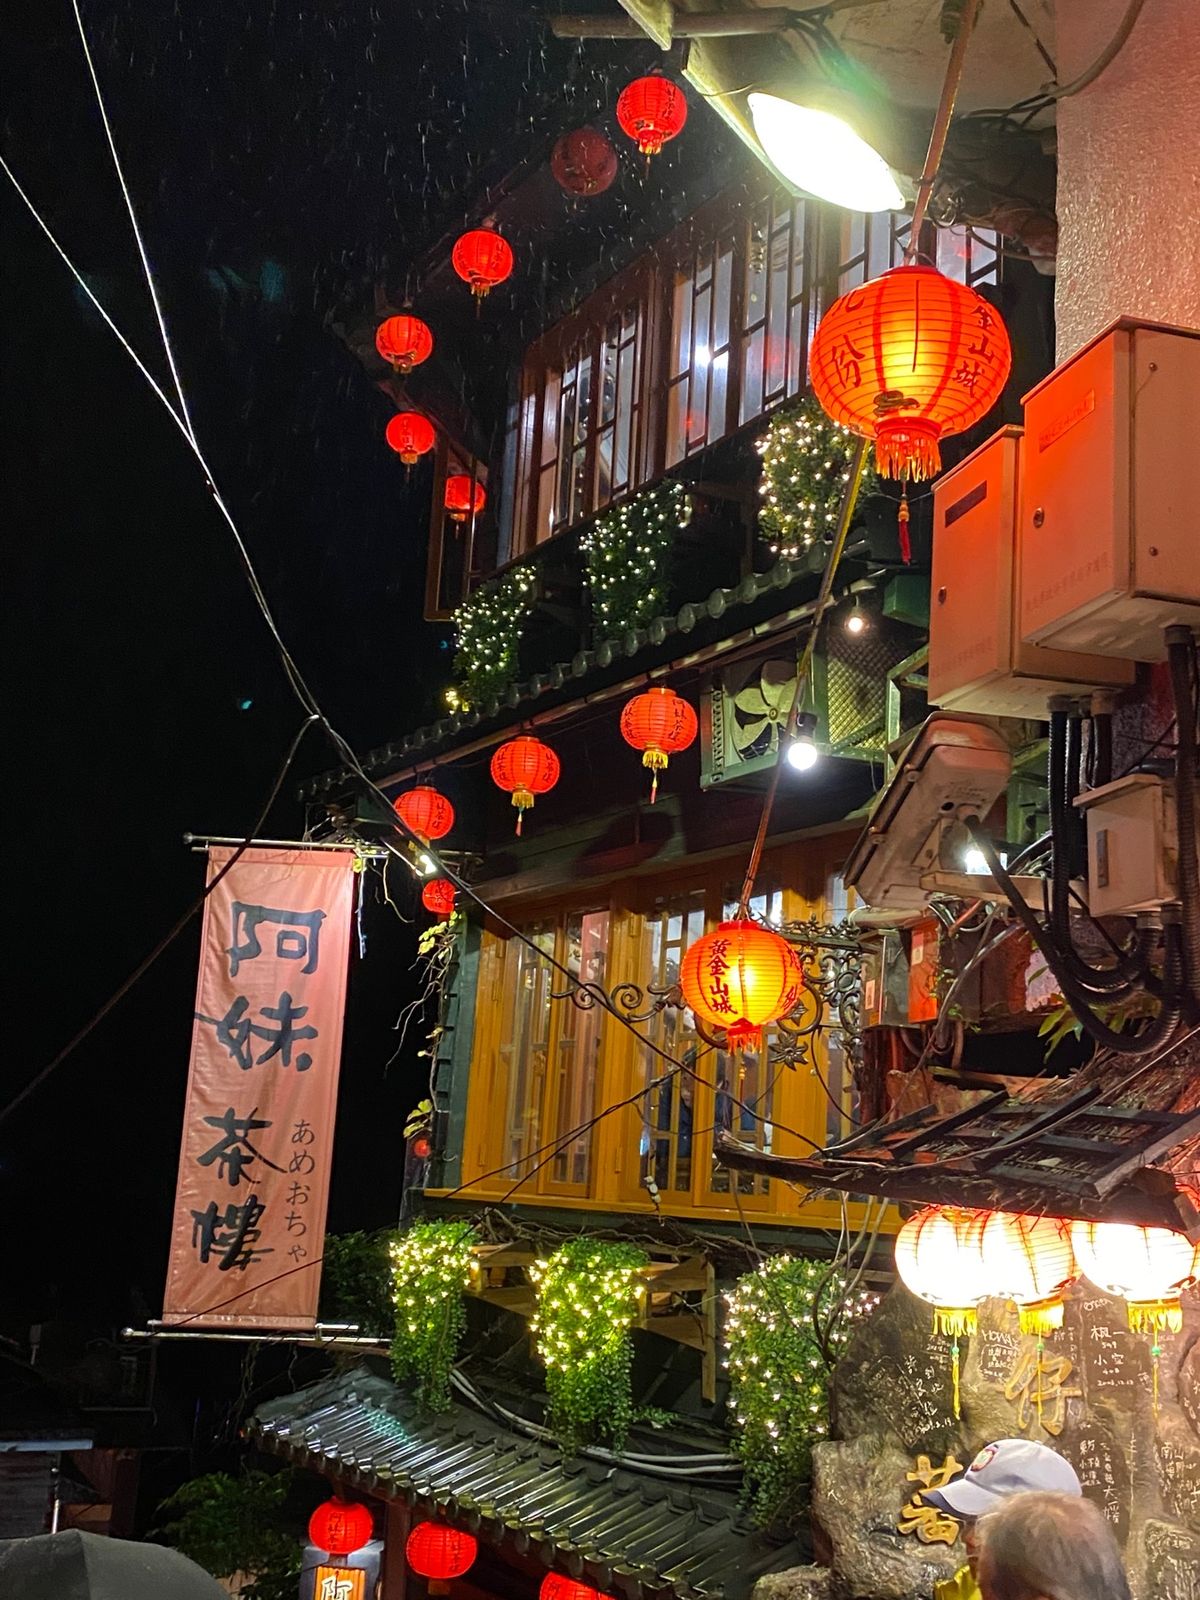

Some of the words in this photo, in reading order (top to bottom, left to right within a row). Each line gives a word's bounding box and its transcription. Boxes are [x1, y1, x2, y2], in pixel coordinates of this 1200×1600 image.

[952, 293, 999, 398] 金山城
[285, 1120, 316, 1262] あめおちゃ
